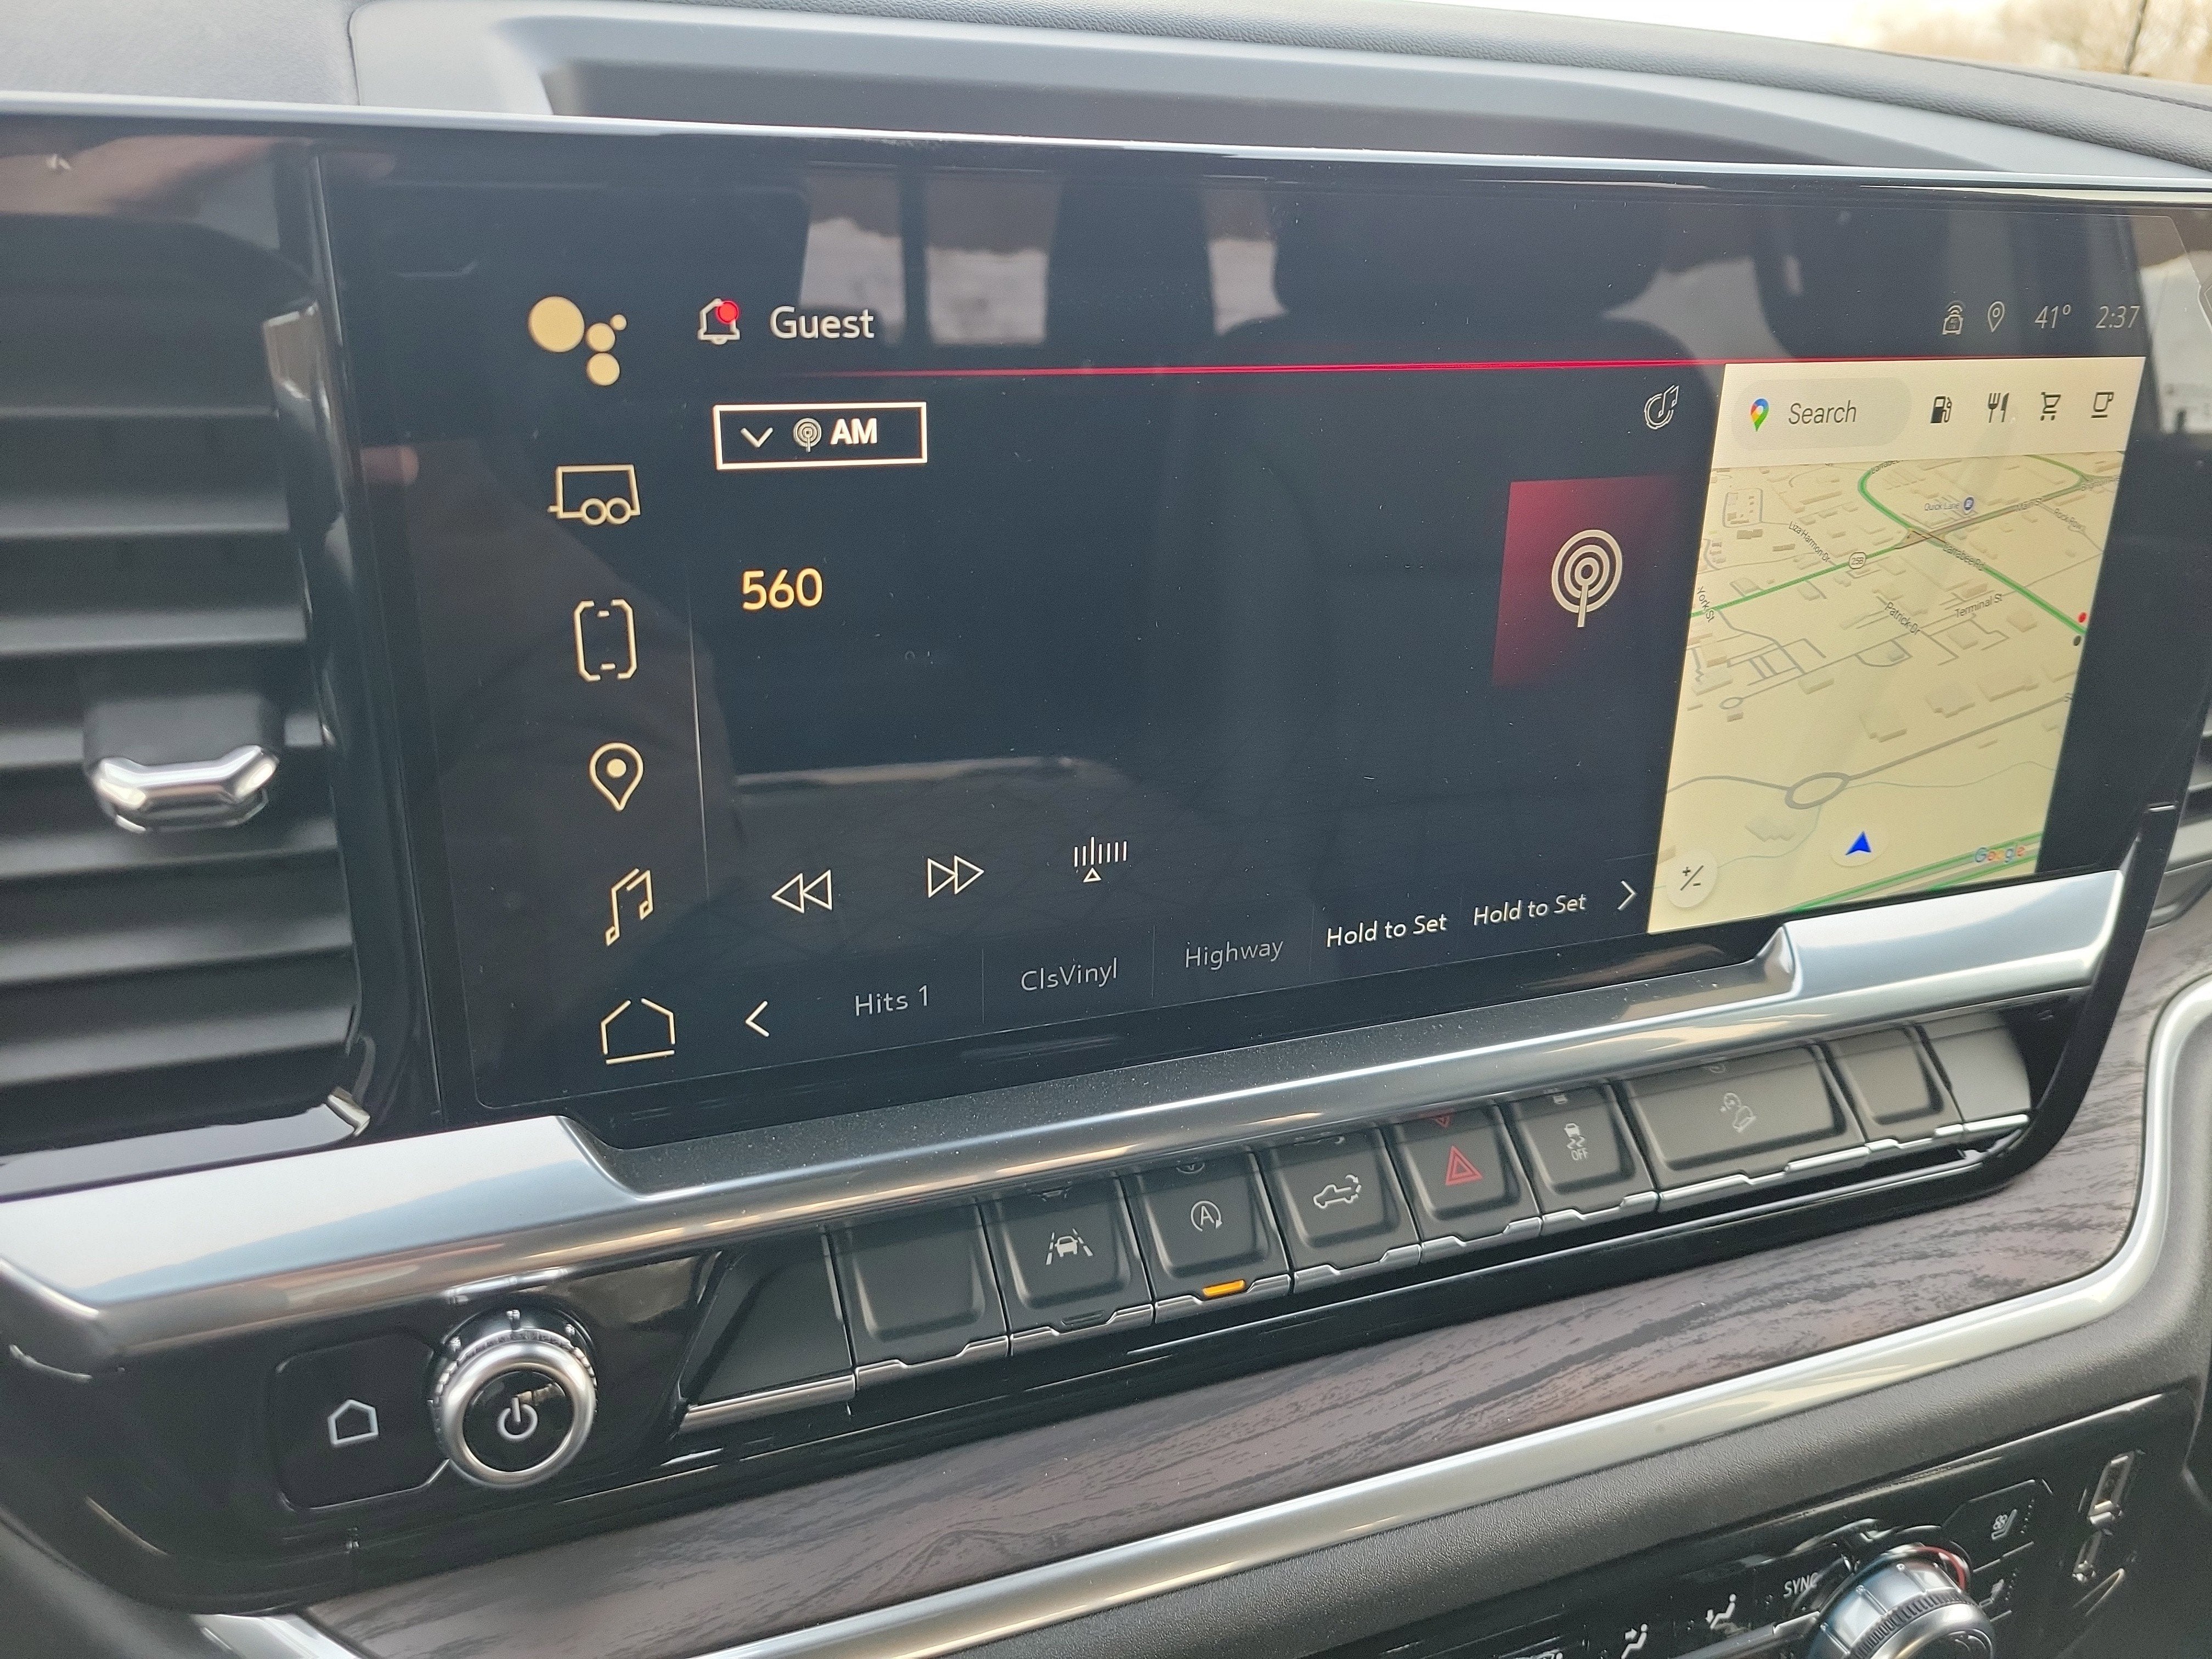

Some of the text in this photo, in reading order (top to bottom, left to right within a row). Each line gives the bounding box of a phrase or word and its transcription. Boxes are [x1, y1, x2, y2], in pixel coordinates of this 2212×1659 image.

[771, 306, 874, 339] Guest
[2096, 305, 2140, 329] 2:37
[1788, 399, 1857, 426] Search
[831, 418, 877, 445] AM
[1925, 502, 1960, 511] Quick Lane
[1788, 521, 1830, 562] Liza Harmon Dr
[1943, 543, 1985, 571] Larrabee Rd
[742, 568, 823, 610] 560
[1697, 586, 1715, 622] York St
[1884, 602, 1920, 635] Patrick Dr
[1955, 593, 2002, 618] Terminal St
[1975, 847, 2025, 863] Google
[1474, 893, 1587, 926] Hold to Set
[1327, 913, 1447, 948] Hold to Set
[1185, 940, 1283, 970] Highway
[1021, 957, 1118, 991] ClsVinyl
[855, 985, 928, 1017] Hits 1
[1571, 1148, 1588, 1161] OFF
[1200, 1206, 1215, 1225] A
[1784, 1572, 1819, 1598] SYNC
